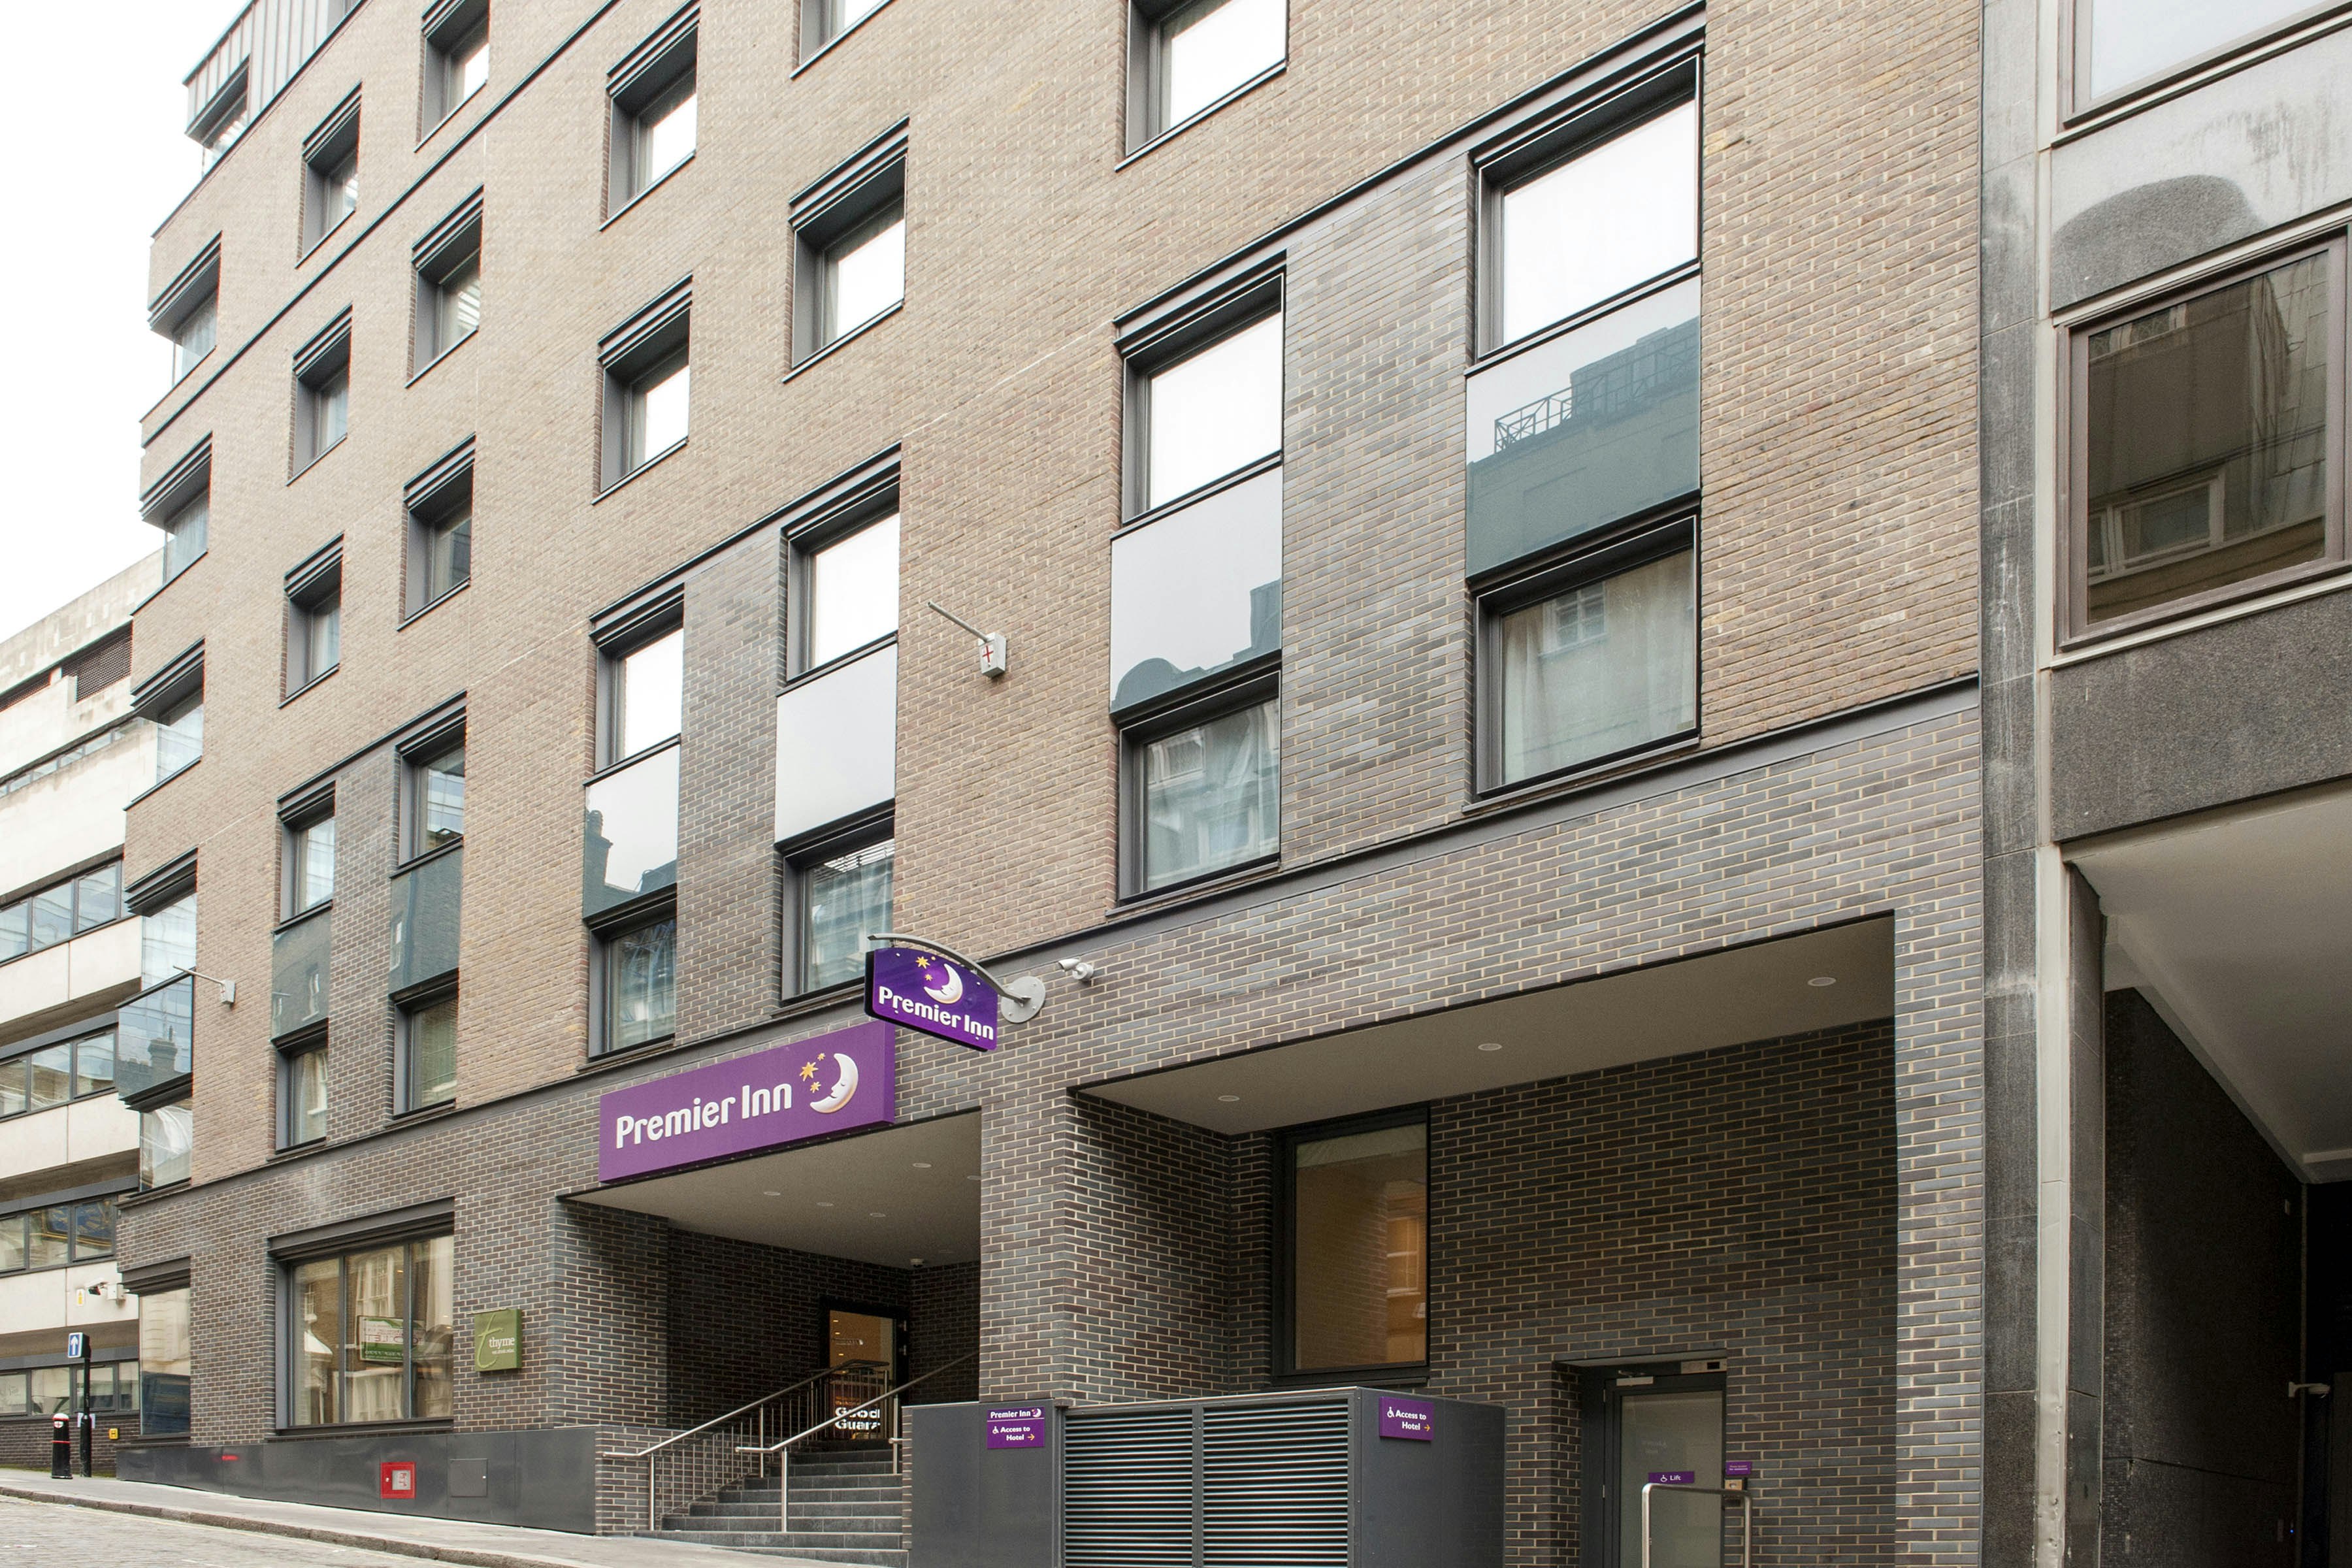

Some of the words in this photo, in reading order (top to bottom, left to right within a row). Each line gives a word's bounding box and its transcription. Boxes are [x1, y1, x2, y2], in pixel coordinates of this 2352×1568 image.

[878, 986, 961, 1028] Premier
[964, 1014, 994, 1040] Inn
[616, 1097, 736, 1149] Premier
[742, 1083, 792, 1119] Inn
[489, 1337, 515, 1349] thyme
[1395, 1409, 1418, 1420] Access
[1401, 1421, 1421, 1431] Hotel
